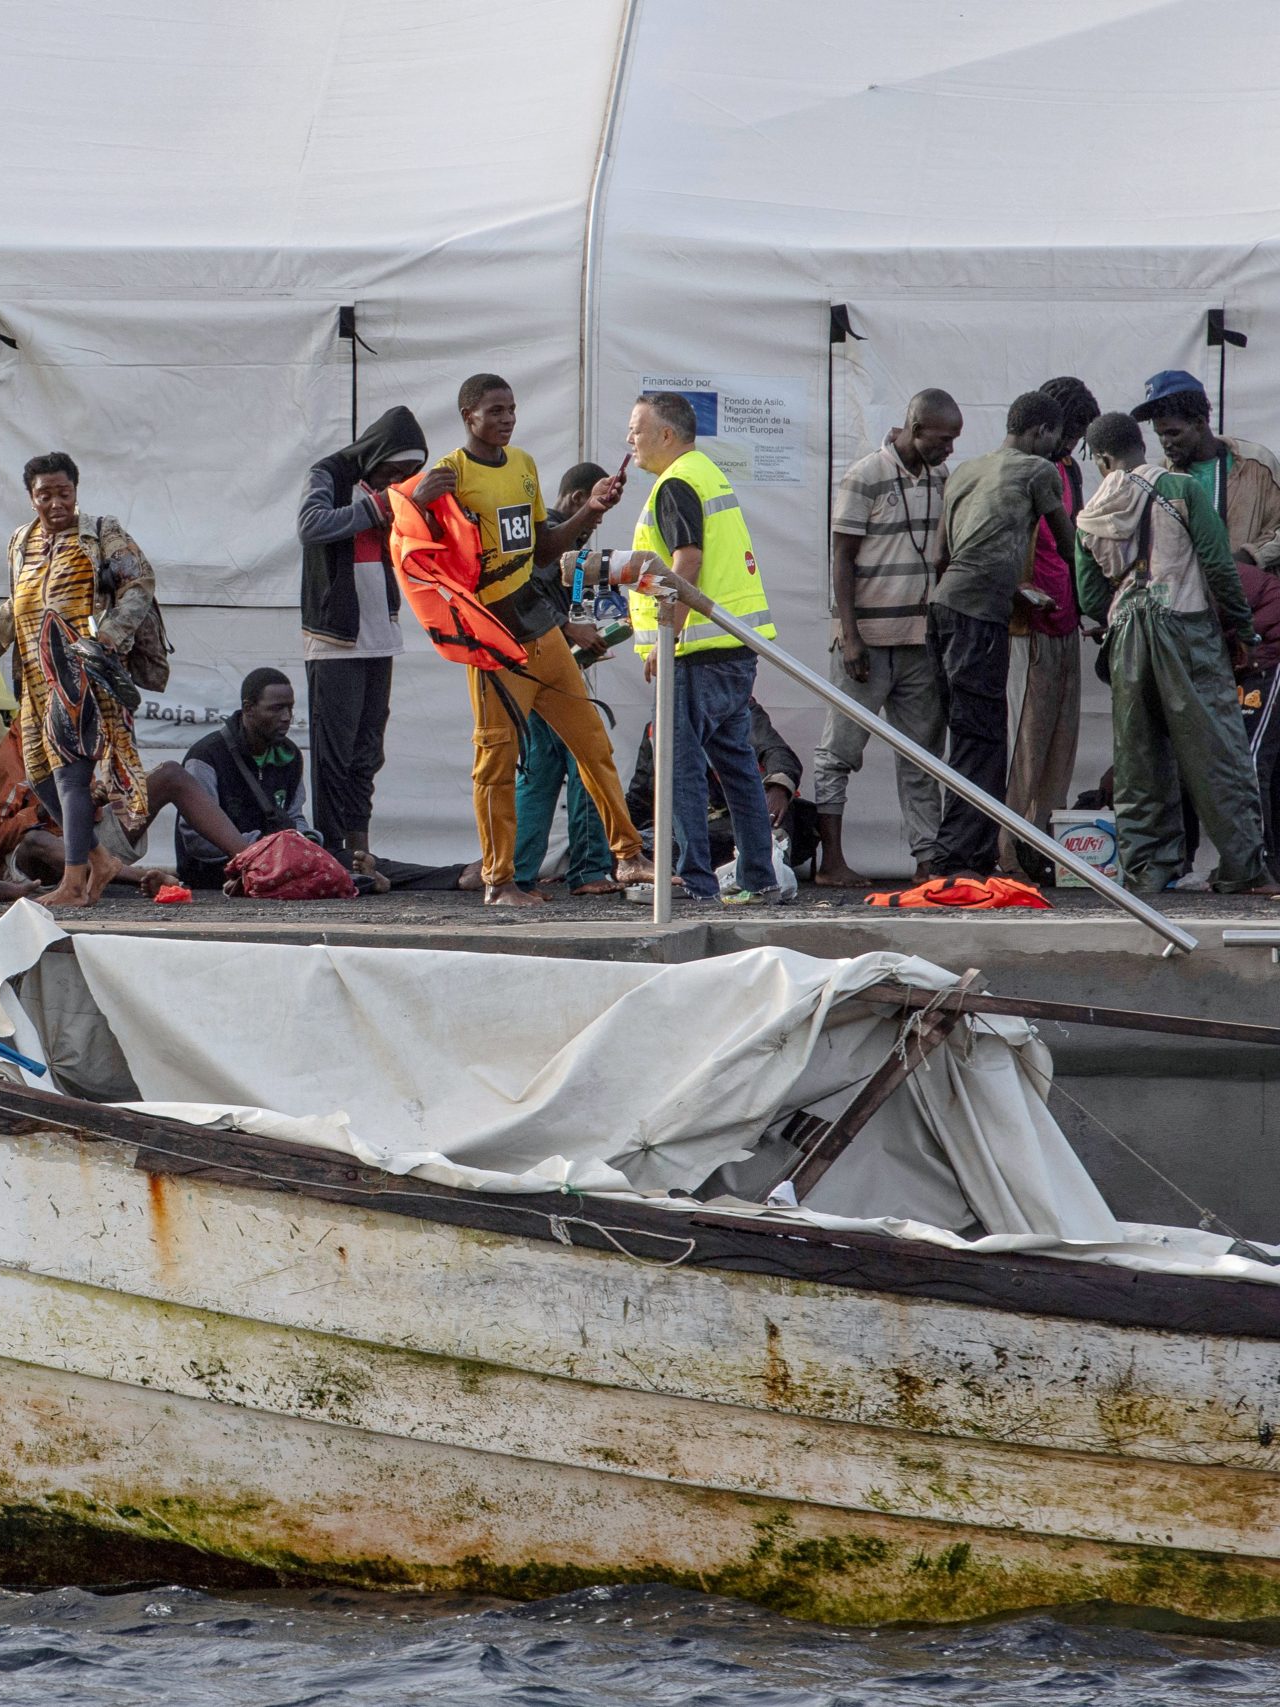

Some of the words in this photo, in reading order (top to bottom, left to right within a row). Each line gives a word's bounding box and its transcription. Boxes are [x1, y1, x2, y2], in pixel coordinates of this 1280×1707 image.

[642, 377, 694, 387] Financiado
[696, 379, 712, 388] por
[724, 397, 751, 406] Fondo
[752, 397, 762, 406] de
[763, 397, 786, 408] Asilo,
[724, 406, 763, 416] Migración
[724, 415, 769, 426] Integración
[770, 416, 781, 425] de
[783, 416, 791, 425] la
[724, 425, 748, 433] Unión
[750, 425, 784, 436] Europea
[501, 514, 530, 541] 1&1
[145, 701, 196, 726] Roja
